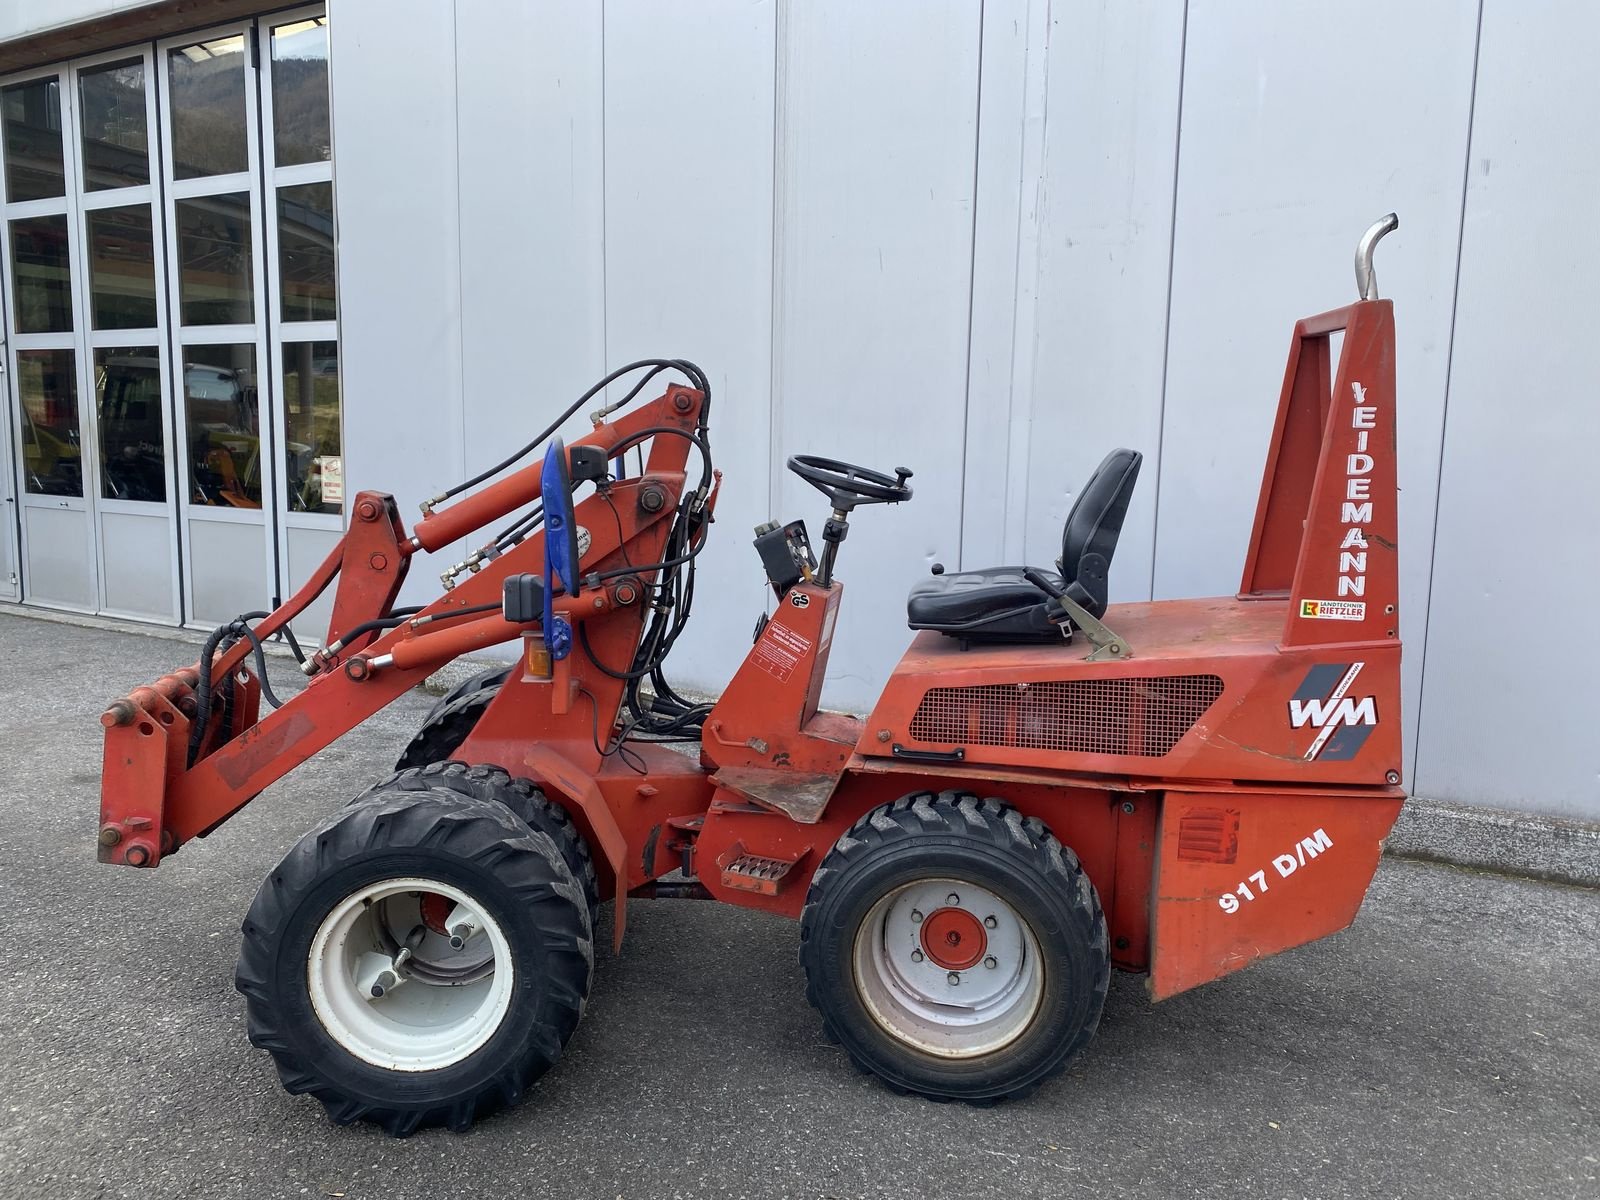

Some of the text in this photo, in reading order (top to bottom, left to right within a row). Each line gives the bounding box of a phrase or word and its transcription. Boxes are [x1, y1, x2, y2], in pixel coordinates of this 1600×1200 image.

[791, 594, 809, 607] GS
[1320, 607, 1363, 616] RIETZLER
[1288, 695, 1378, 729] WM
[1218, 828, 1334, 914] 917 D/M
